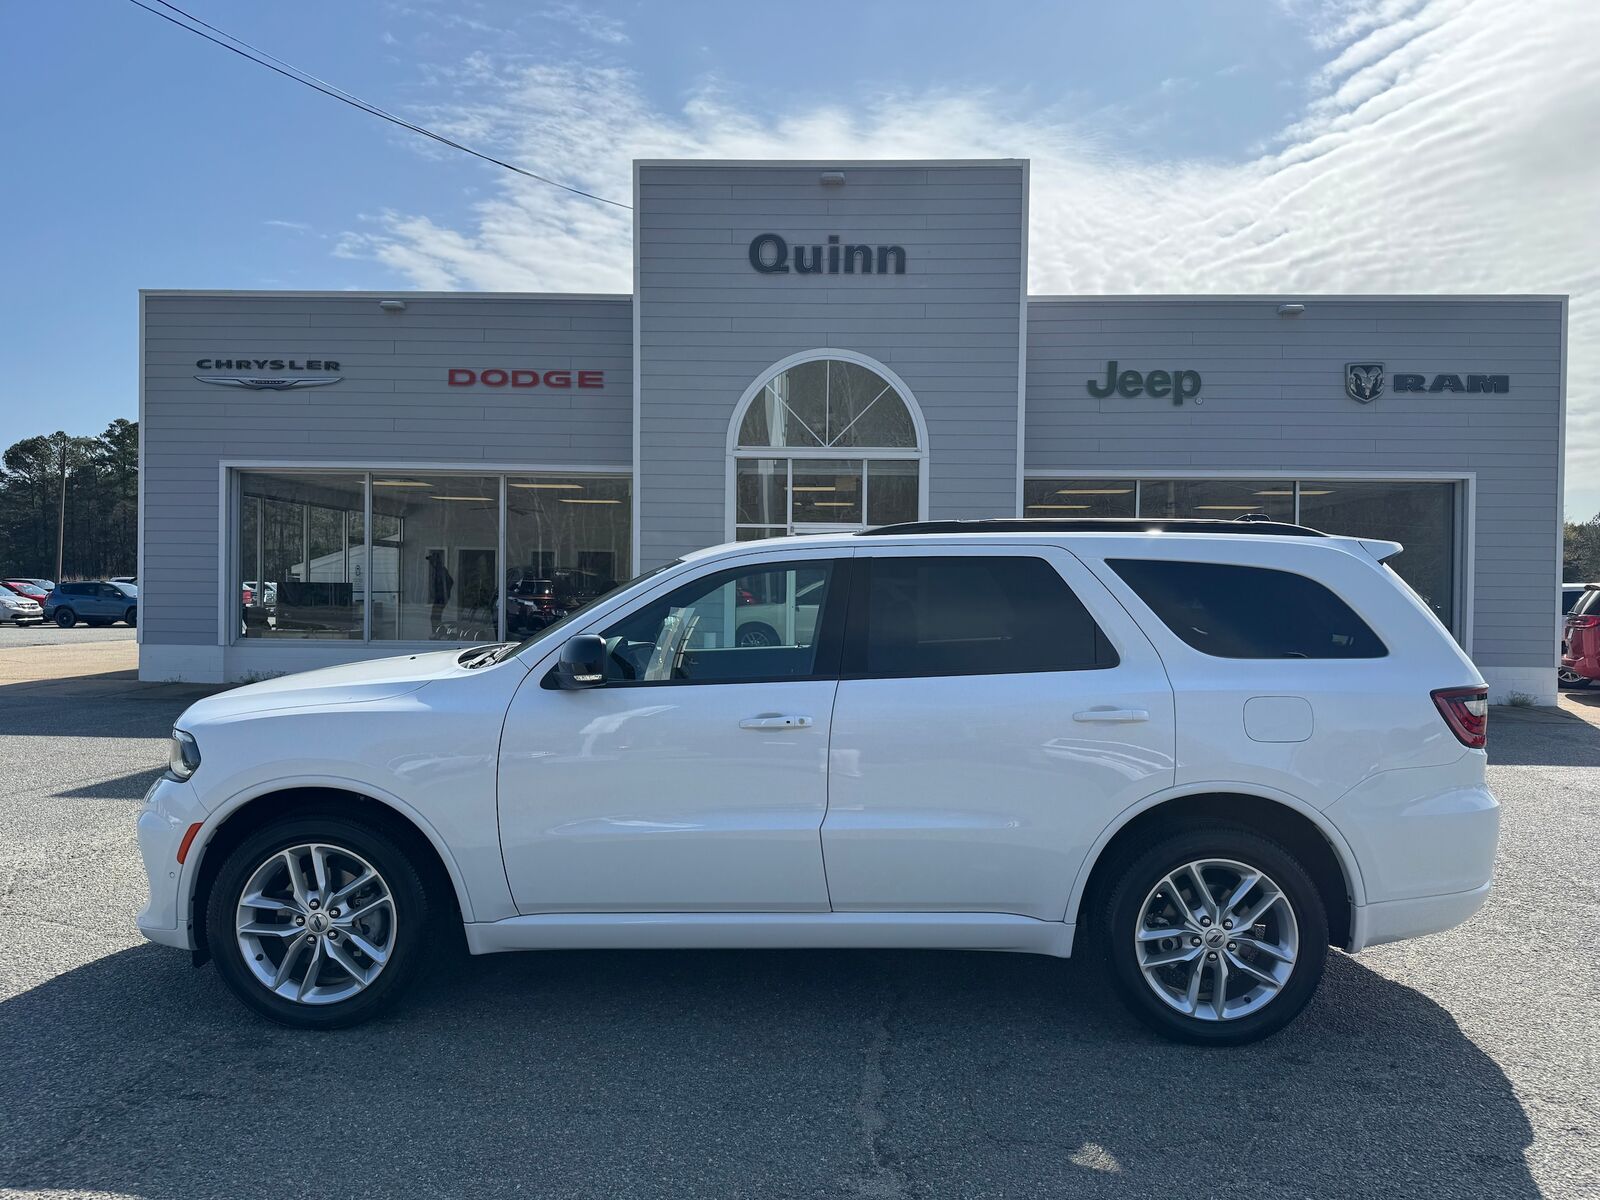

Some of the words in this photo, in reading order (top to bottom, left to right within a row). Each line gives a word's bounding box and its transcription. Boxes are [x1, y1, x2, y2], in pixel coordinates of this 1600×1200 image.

[748, 232, 906, 276] Quinn
[196, 358, 341, 371] CHRYSLER
[447, 368, 605, 389] DODGE
[1087, 360, 1202, 406] Jeep
[1393, 373, 1510, 393] RAM
